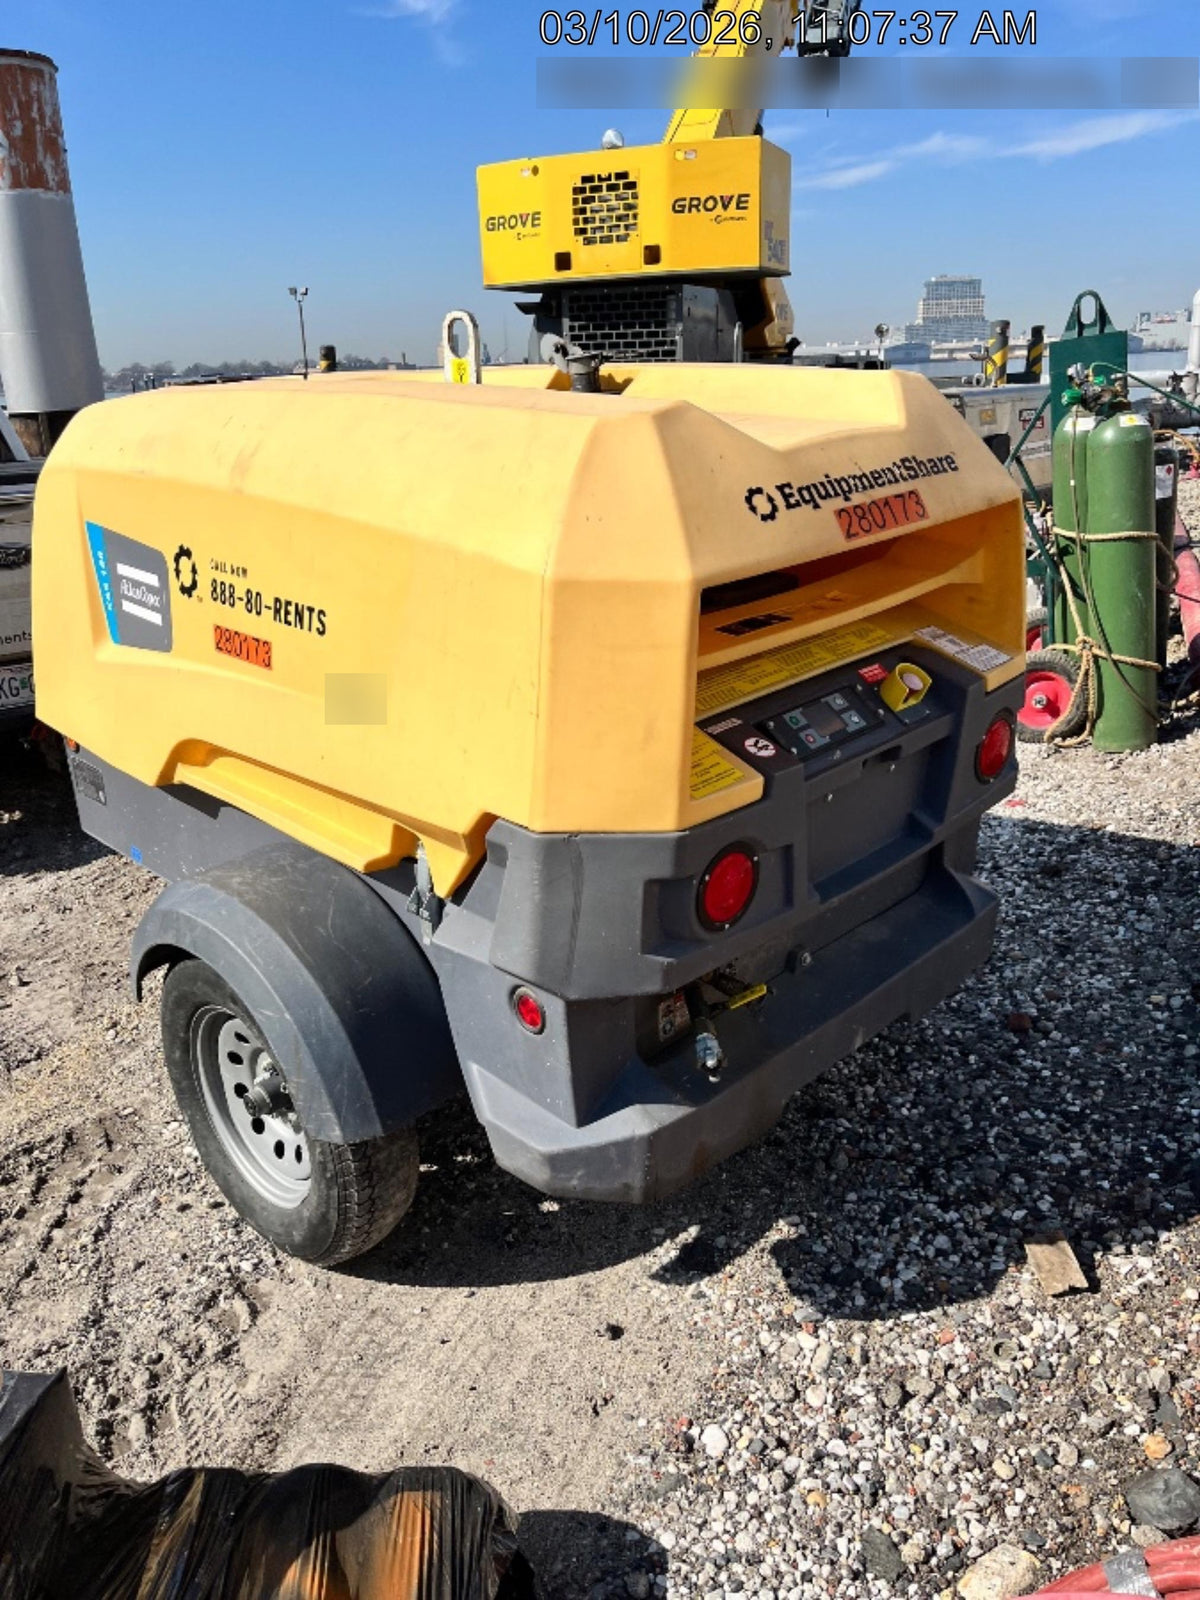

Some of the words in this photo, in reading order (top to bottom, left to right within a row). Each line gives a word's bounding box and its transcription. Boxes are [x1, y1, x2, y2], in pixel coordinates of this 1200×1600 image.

[486, 211, 541, 232] GROVE
[672, 193, 750, 214] GROVE
[775, 453, 959, 510] EquipmentShare
[838, 490, 927, 540] 280173
[210, 557, 228, 574] CALL
[211, 578, 327, 637] 888-80-RENTS
[215, 625, 271, 668] 280173
